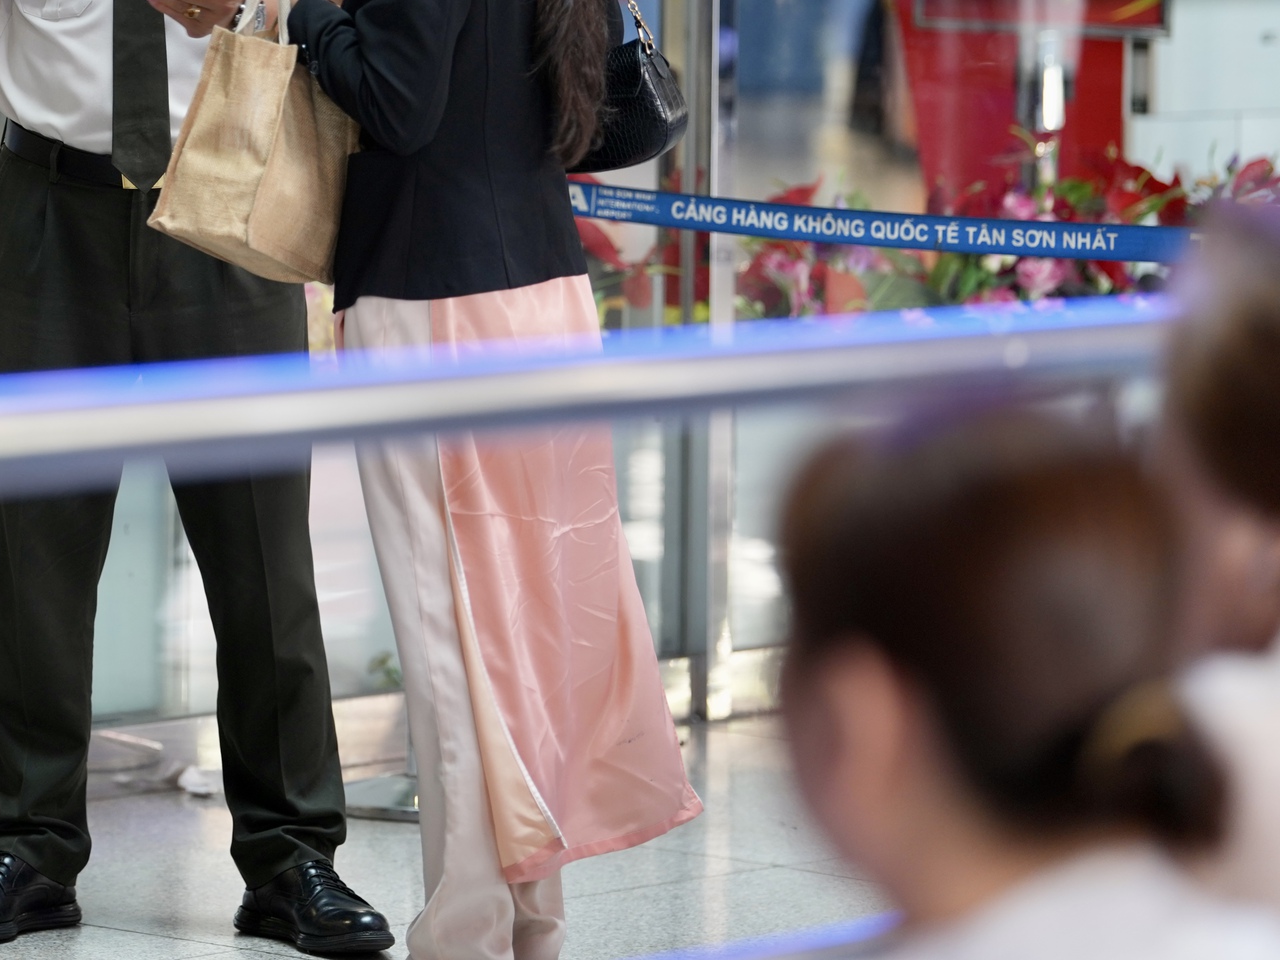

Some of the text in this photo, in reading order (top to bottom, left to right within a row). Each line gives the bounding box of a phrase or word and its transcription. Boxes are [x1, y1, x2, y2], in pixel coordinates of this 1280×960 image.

[670, 197, 728, 225] CẢNG
[793, 212, 866, 238] KHÔNG
[870, 217, 929, 243] QUỐC
[934, 221, 960, 245] TẾ
[965, 223, 1006, 247] TÂN
[1011, 228, 1056, 249] SƠN
[1062, 227, 1119, 252] NHẤT
